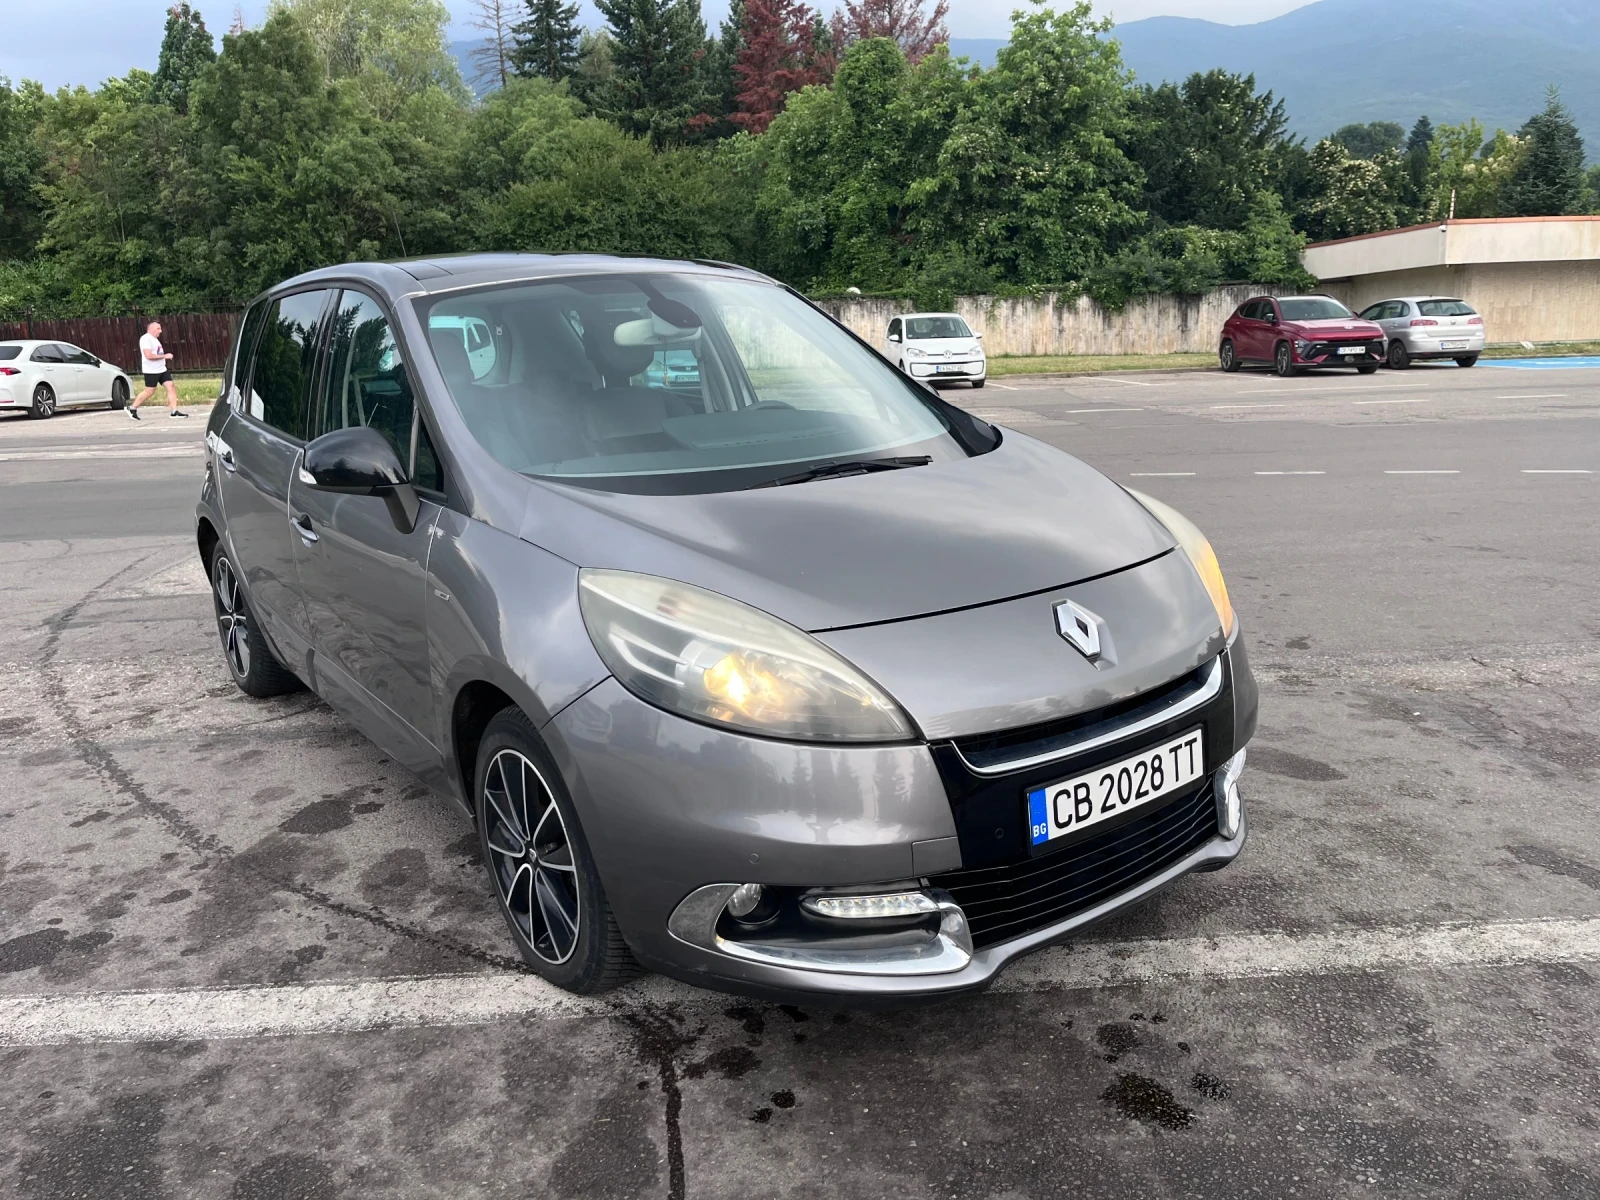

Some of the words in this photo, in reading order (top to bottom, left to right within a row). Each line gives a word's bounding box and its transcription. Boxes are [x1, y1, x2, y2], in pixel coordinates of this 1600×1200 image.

[1053, 782, 1093, 829] CB
[1099, 754, 1164, 814] 2028
[1169, 737, 1198, 782] TT
[1033, 823, 1047, 837] BG
